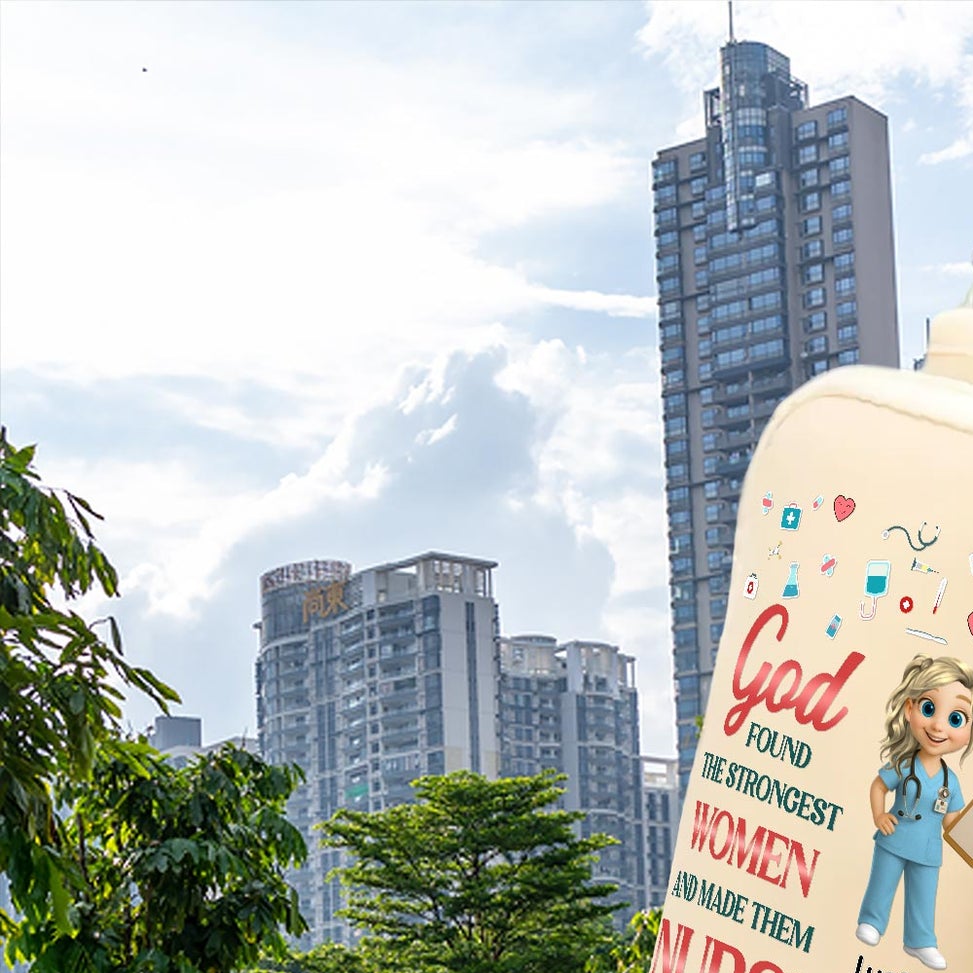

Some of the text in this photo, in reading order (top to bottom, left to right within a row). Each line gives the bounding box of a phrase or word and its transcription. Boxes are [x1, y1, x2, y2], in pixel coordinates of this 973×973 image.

[724, 604, 866, 736] God
[745, 722, 812, 769] FOUND
[702, 752, 844, 831] THE STRONGEST
[691, 800, 821, 898] WOMEN
[671, 871, 815, 953] AND MADE THEM
